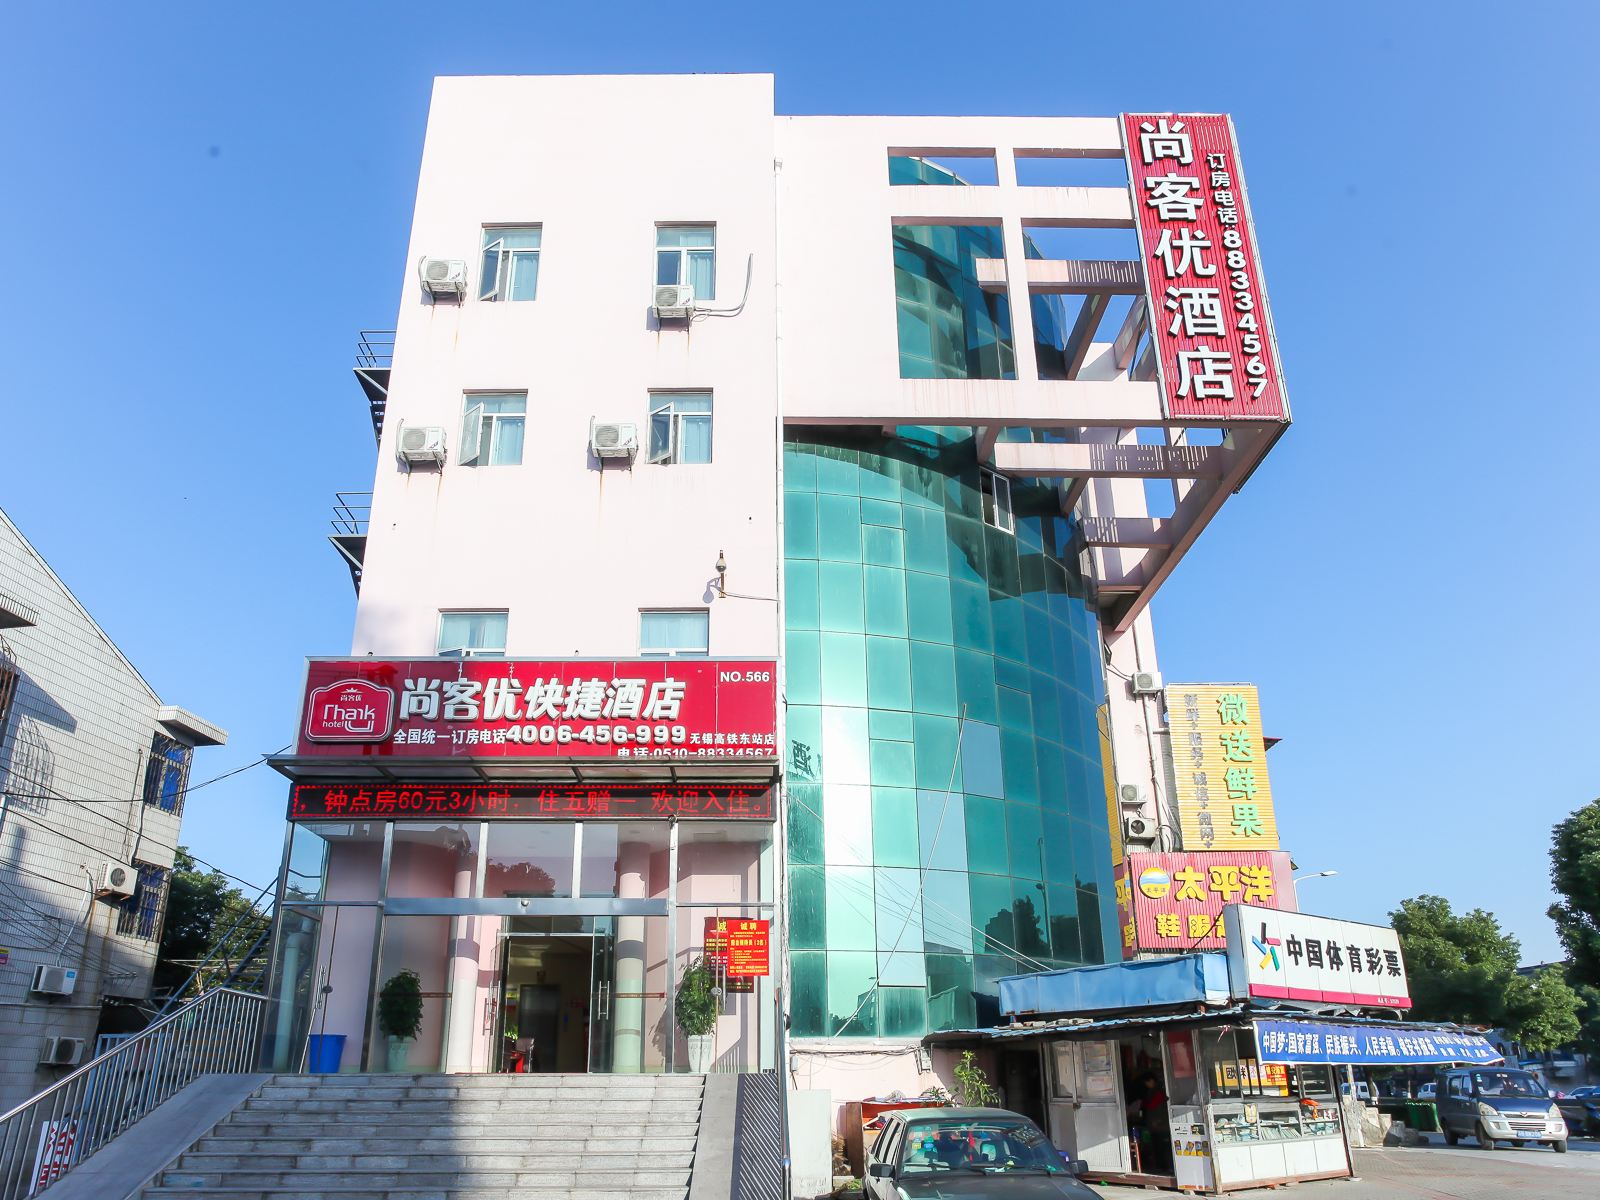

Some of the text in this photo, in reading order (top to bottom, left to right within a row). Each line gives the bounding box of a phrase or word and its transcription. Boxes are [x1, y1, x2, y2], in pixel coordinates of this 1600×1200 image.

[1139, 118, 1236, 400] 尚客优酒店
[1206, 152, 1268, 399] 订房电话:88334567
[399, 677, 686, 721] 尚客优快捷酒店
[720, 671, 770, 683] NO.566
[322, 720, 344, 728] hotel
[690, 732, 775, 745] 无锡高铁东站店
[1216, 692, 1264, 837] 微送鲜果
[1174, 865, 1275, 902] 太平洋
[1286, 933, 1402, 977] 中国体育彩票
